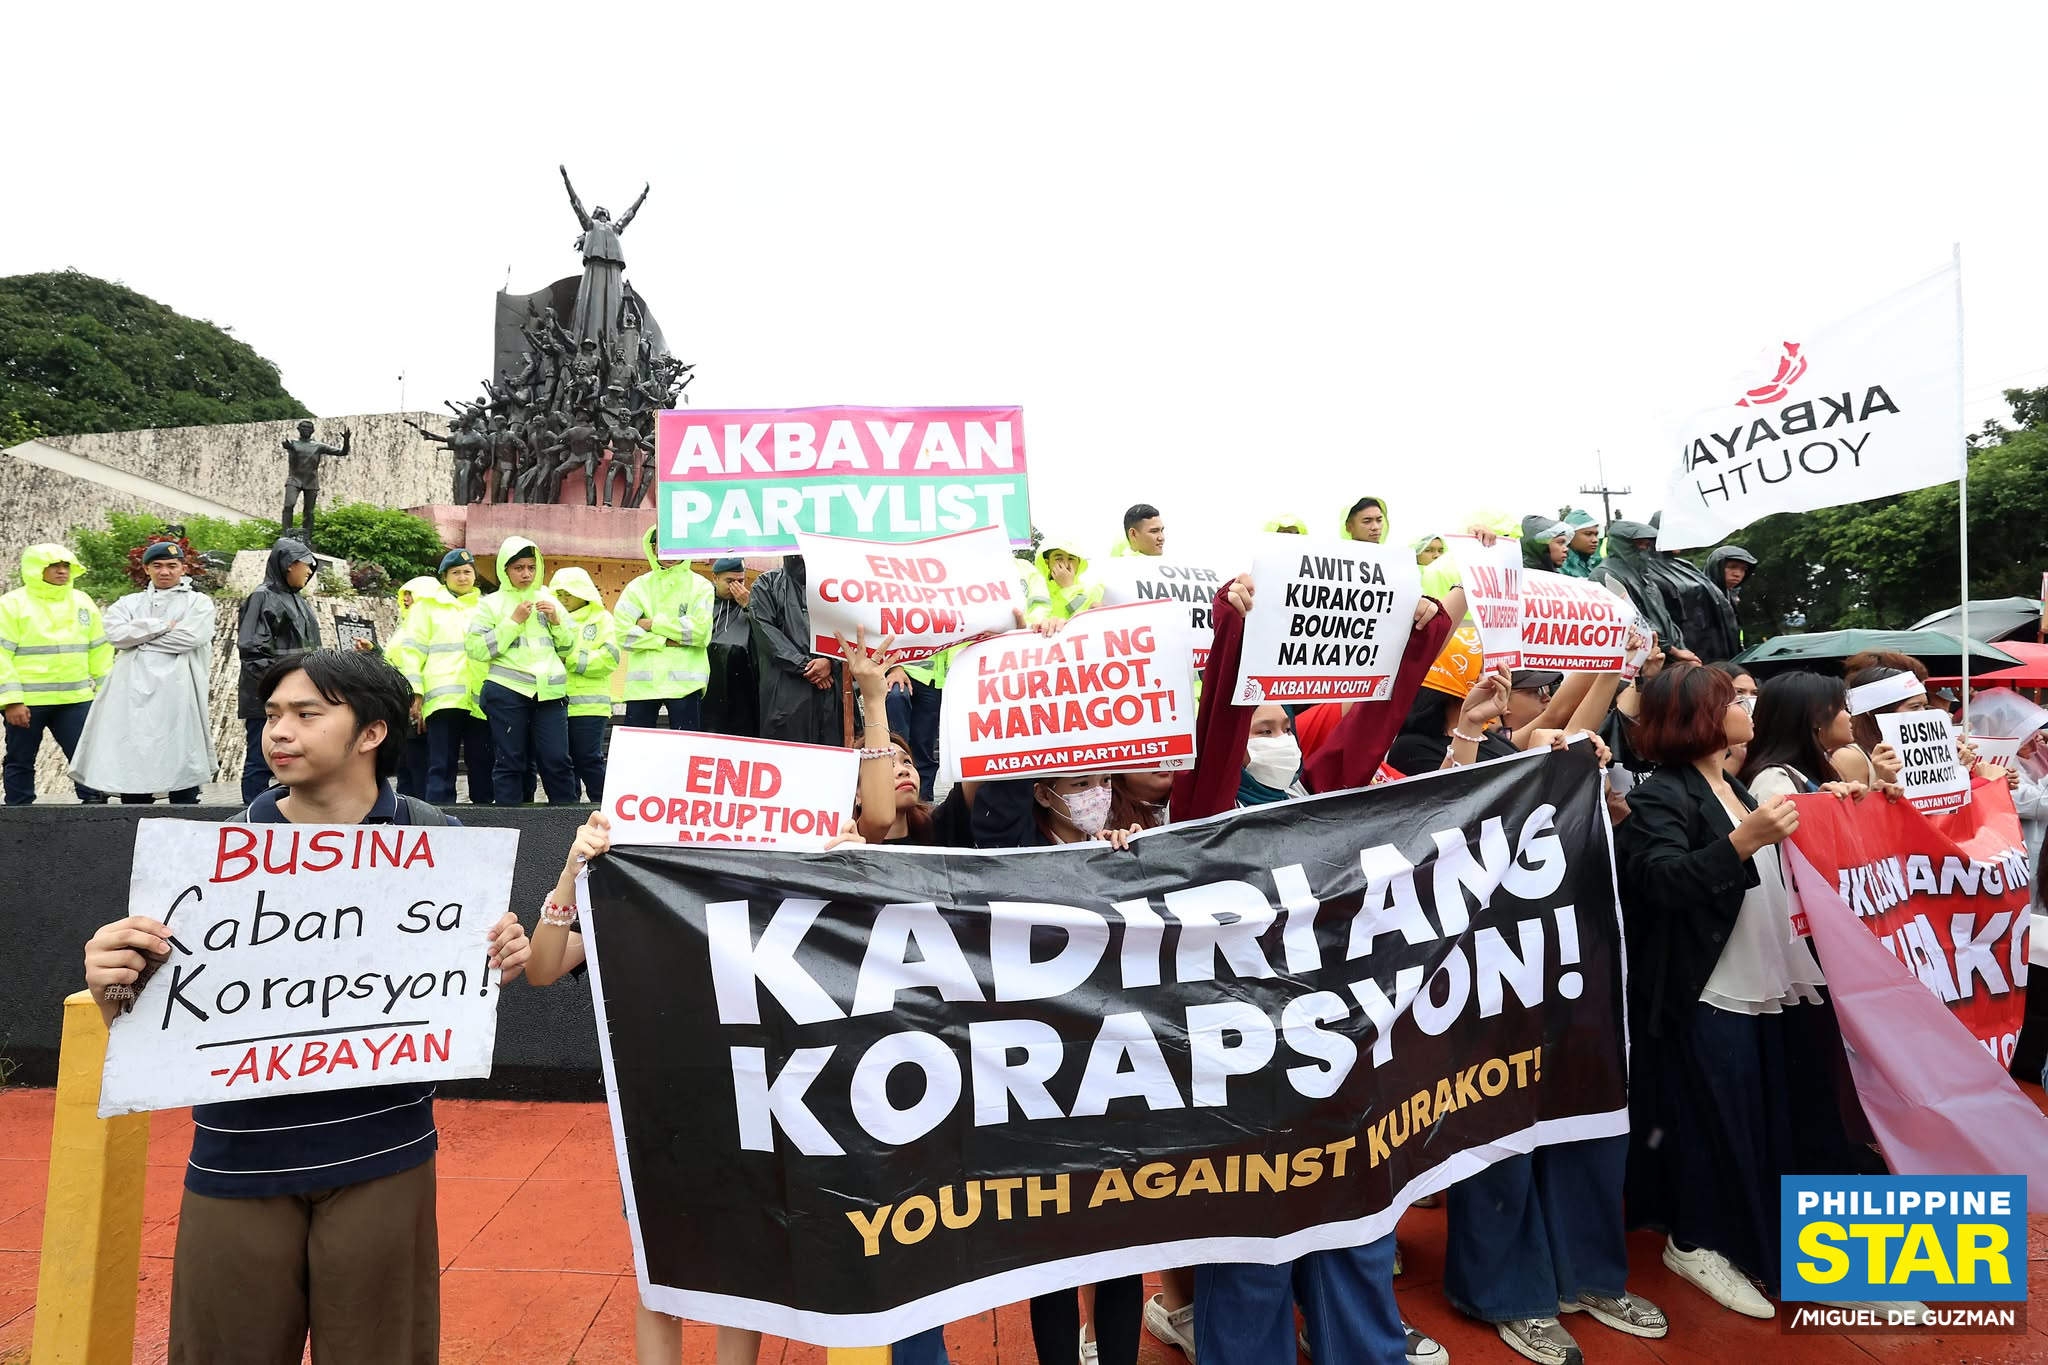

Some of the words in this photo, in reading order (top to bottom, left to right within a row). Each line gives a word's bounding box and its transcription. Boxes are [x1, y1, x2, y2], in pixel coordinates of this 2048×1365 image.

[670, 420, 1015, 475] AKBAYAN
[671, 483, 1015, 539] PARTYLIST
[866, 554, 947, 584] END
[1159, 565, 1220, 582] OVER
[1299, 554, 1355, 581] AWIT
[1359, 561, 1386, 586] SA
[1469, 565, 1503, 600] JAIL
[1505, 567, 1519, 601] ALL
[819, 578, 1011, 607] CORRUPTION
[1285, 583, 1394, 613] KURAKOT!
[880, 607, 966, 635] NOW!
[1290, 614, 1377, 639] BOUNCE
[1524, 598, 1622, 624] KURAKOT,
[1521, 621, 1626, 648] MANAGOT!
[977, 634, 1089, 677] LAHAT
[1104, 625, 1156, 658] NG
[1278, 643, 1308, 666] NA
[1312, 643, 1379, 667] KAYO!
[1523, 656, 1565, 667] KBAYAN
[1566, 658, 1614, 668] PARTYLIST
[977, 658, 1161, 705] KURAKOT,
[1269, 680, 1331, 696] AKBAYAN
[1332, 680, 1372, 694] YOUTH
[968, 690, 1177, 742] MANAGOT!
[1900, 720, 1948, 745] BUSINA
[984, 752, 1070, 772] AKBAYAN
[1072, 741, 1169, 763] PARTYLIST
[1903, 744, 1953, 768] KONTRA
[686, 755, 782, 799] END
[1905, 765, 1956, 787] KURAKOT!
[615, 794, 840, 837] CORRUPTION
[1943, 794, 1962, 805] YOUTH
[209, 826, 436, 883] BUSINA
[1906, 854, 2004, 896] ANG
[397, 900, 463, 934] sa
[705, 862, 1323, 1026] KADIRI
[1348, 803, 1567, 964] ANG
[162, 955, 492, 1031] Korapsyon!
[730, 904, 1585, 1157] KORAPSYON!
[210, 1029, 453, 1087] -AKBAYAN
[845, 1171, 1070, 1257] YOUTH
[1087, 1140, 1360, 1209] AGAINST
[1367, 1046, 1542, 1169] KURAKOT!
